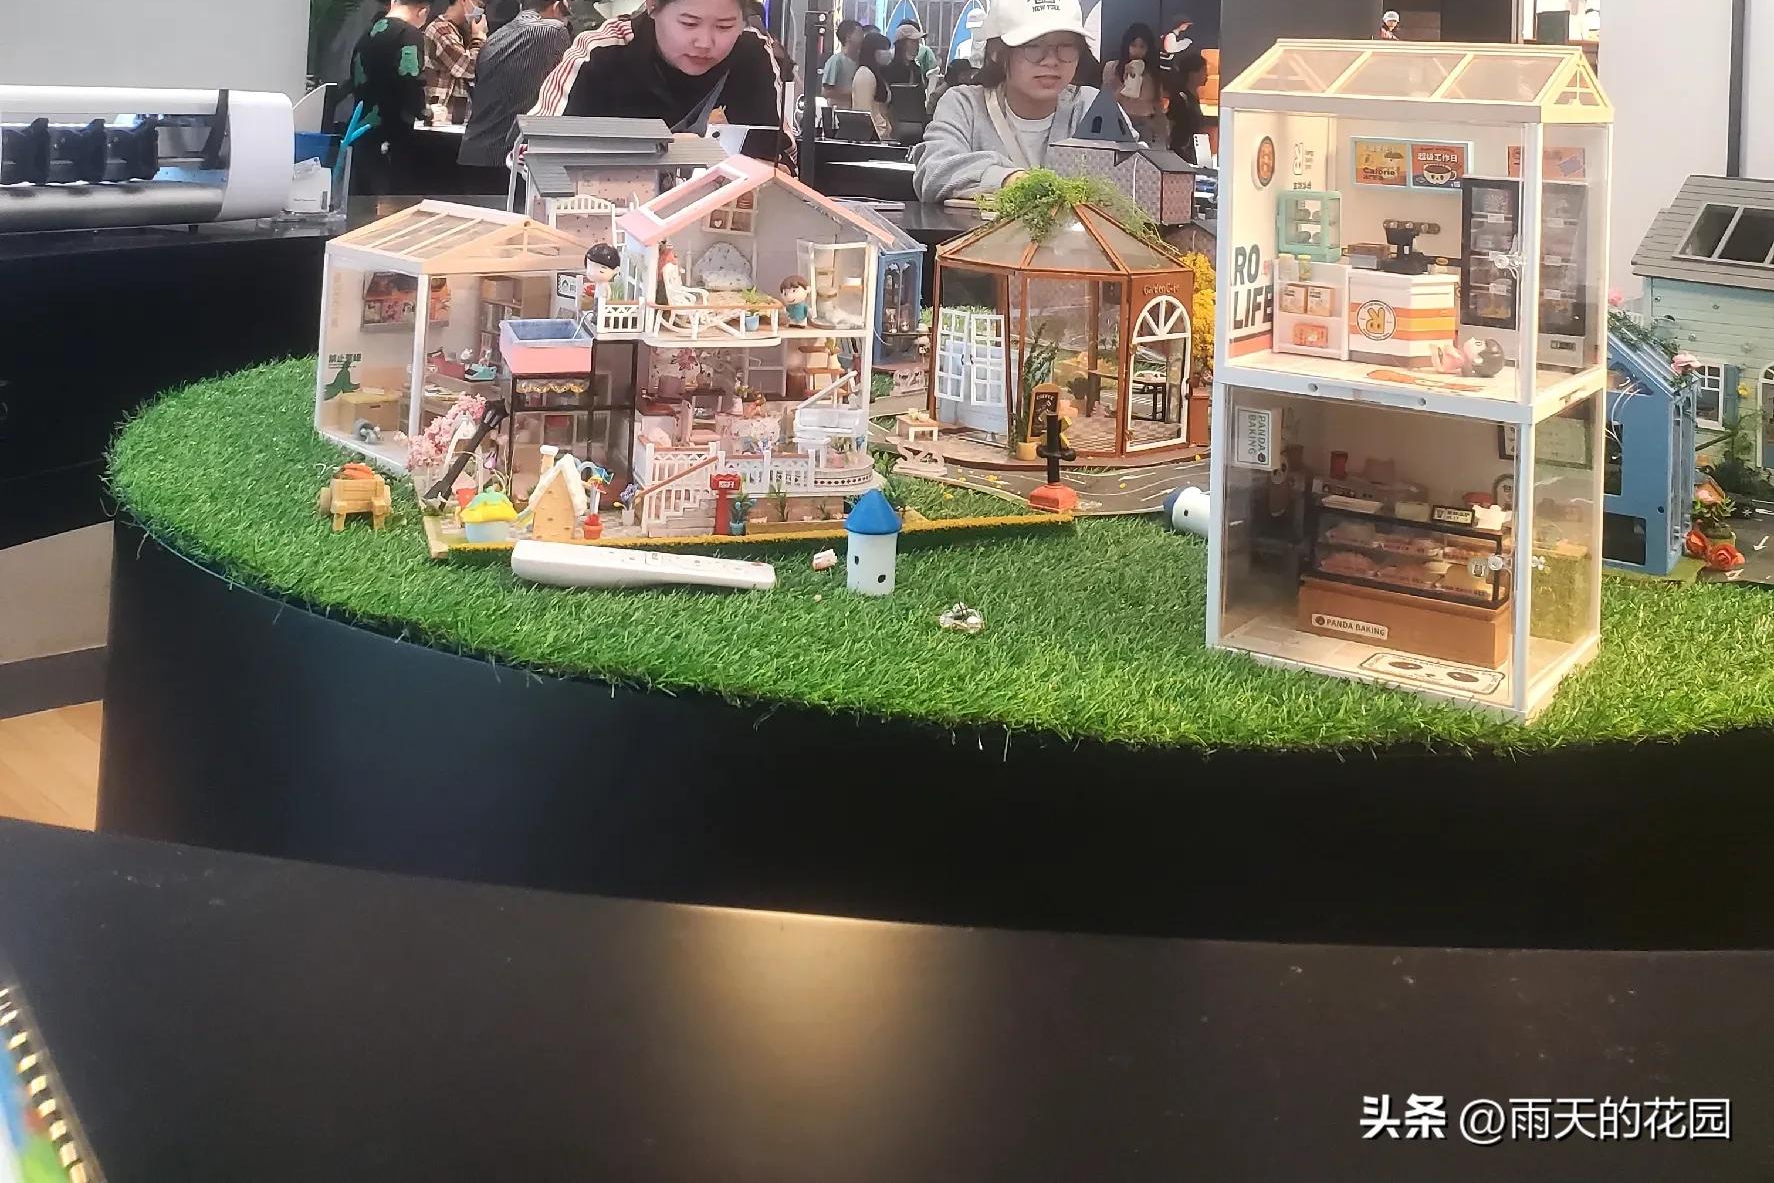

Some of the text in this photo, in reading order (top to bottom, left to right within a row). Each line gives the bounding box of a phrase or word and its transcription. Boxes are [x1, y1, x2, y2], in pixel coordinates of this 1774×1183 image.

[1233, 284, 1273, 330] LIFE
[1248, 414, 1257, 455] BAKING
[1257, 415, 1266, 451] PANDA
[1327, 618, 1385, 636] PANDA BAKING
